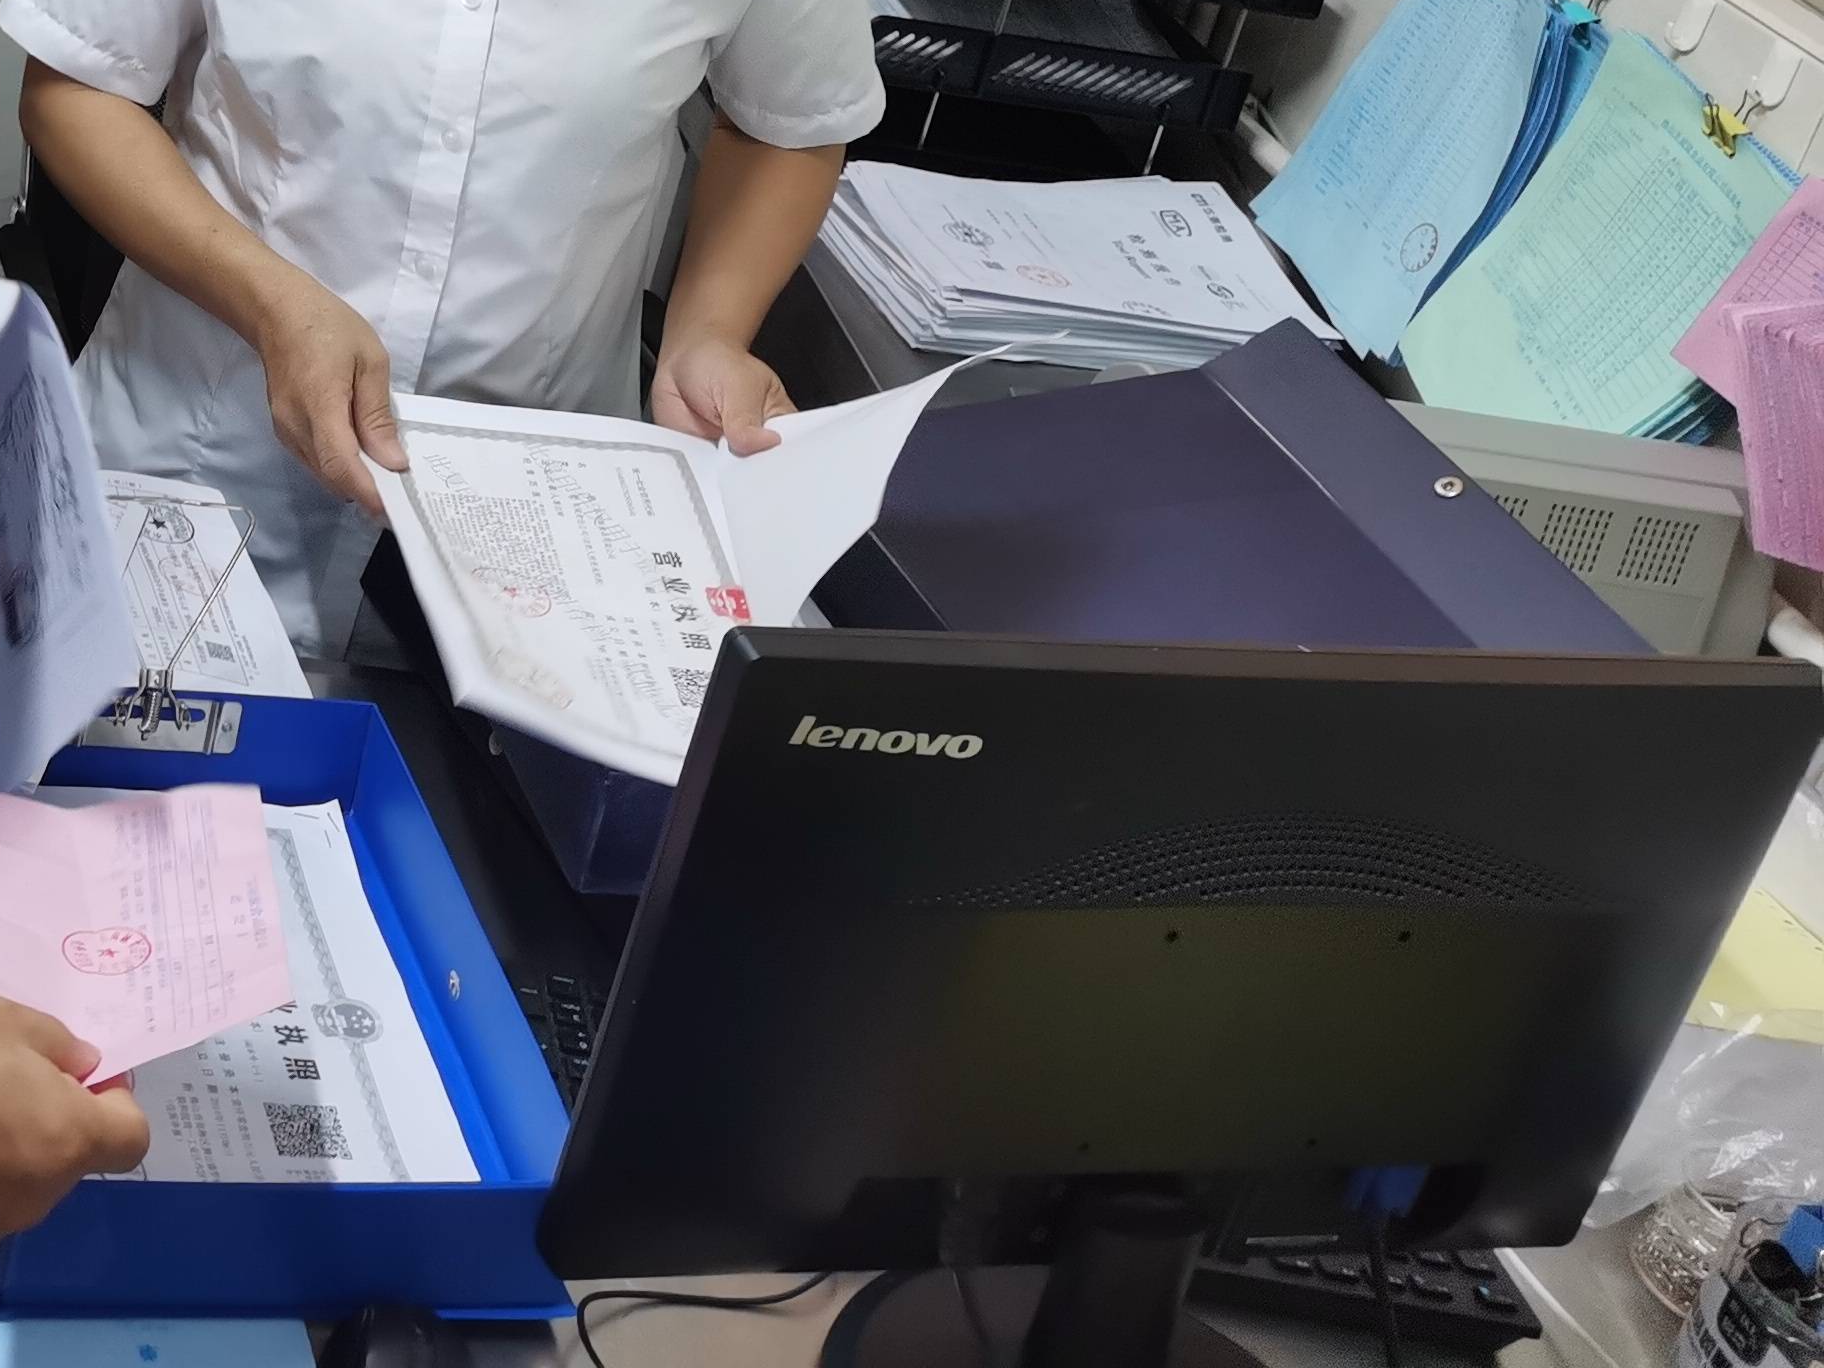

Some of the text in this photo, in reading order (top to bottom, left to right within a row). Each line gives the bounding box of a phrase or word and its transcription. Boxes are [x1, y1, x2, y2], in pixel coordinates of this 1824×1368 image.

[651, 551, 712, 650] 营业执照
[788, 715, 983, 759] lenovo
